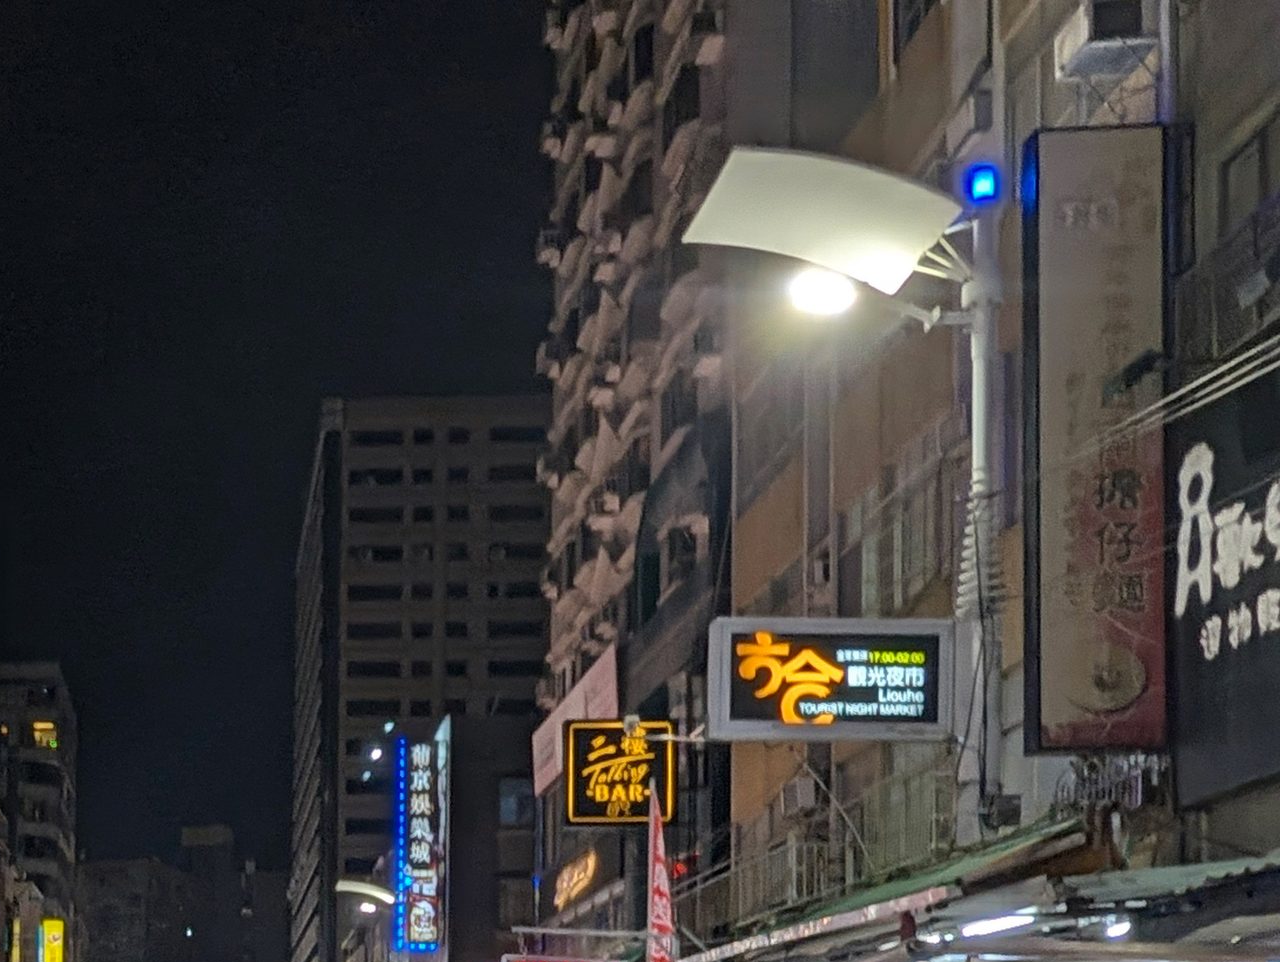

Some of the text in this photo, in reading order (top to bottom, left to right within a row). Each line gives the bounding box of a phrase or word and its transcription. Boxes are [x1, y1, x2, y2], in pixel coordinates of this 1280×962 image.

[845, 703, 878, 716] NIGHT
[879, 703, 925, 717] MARKET
[595, 783, 645, 802] BAR
